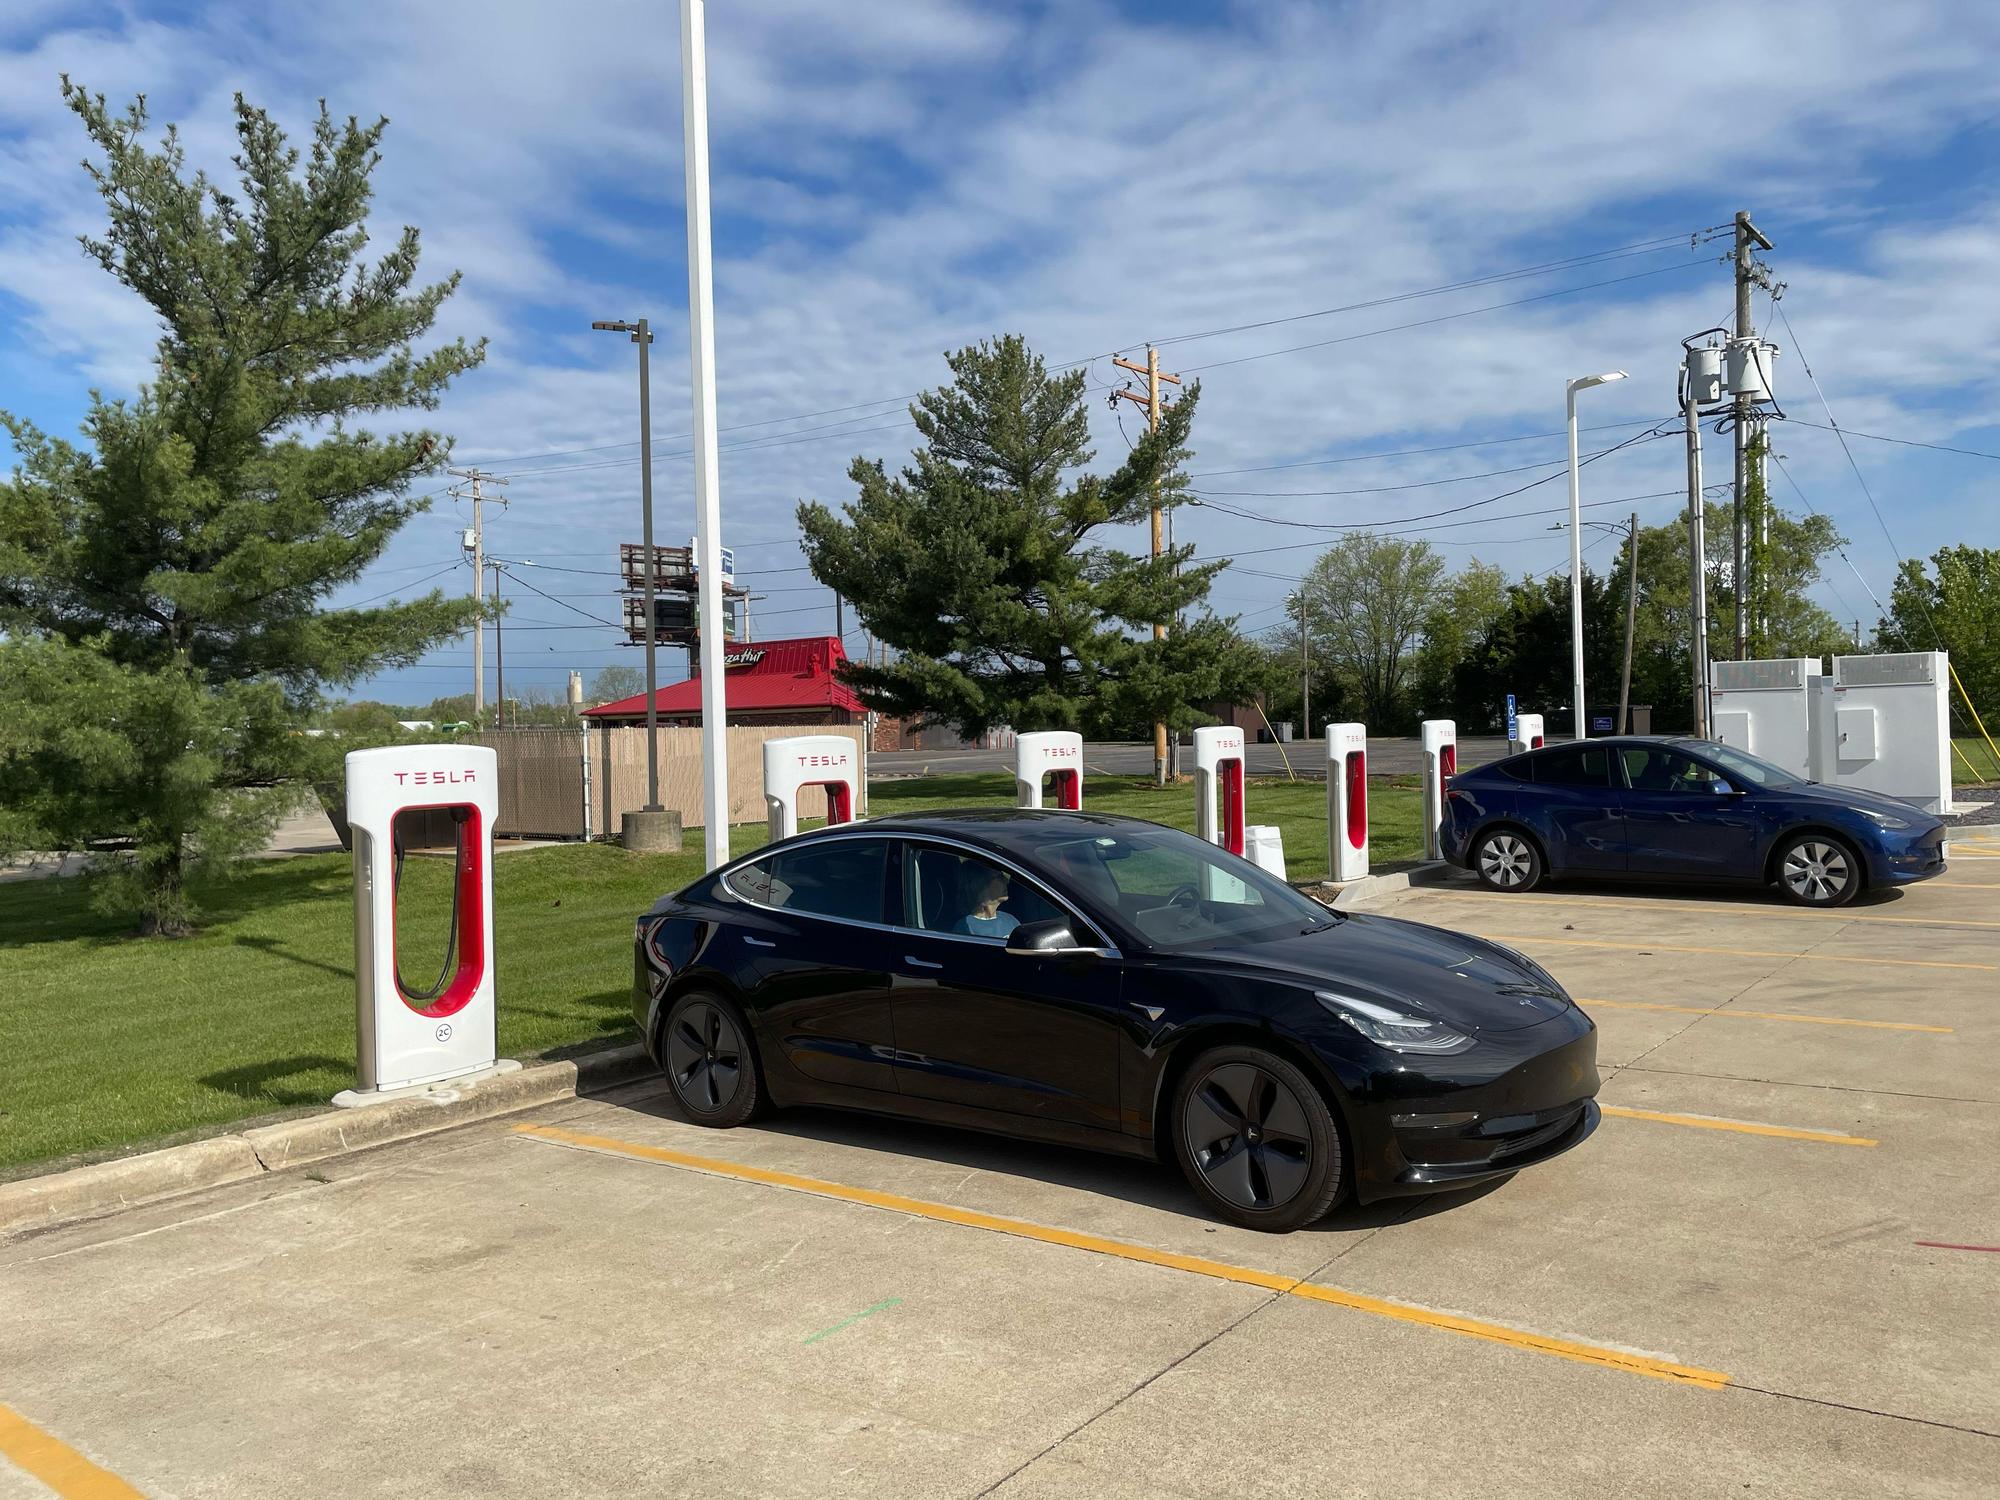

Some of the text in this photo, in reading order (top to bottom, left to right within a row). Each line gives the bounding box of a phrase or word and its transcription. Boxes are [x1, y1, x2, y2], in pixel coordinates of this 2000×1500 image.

[740, 648, 766, 663] Hut
[1042, 747, 1077, 758] TESLA
[797, 755, 847, 767] TESLA
[393, 770, 476, 786] TESLA
[438, 1027, 449, 1037] 2C
